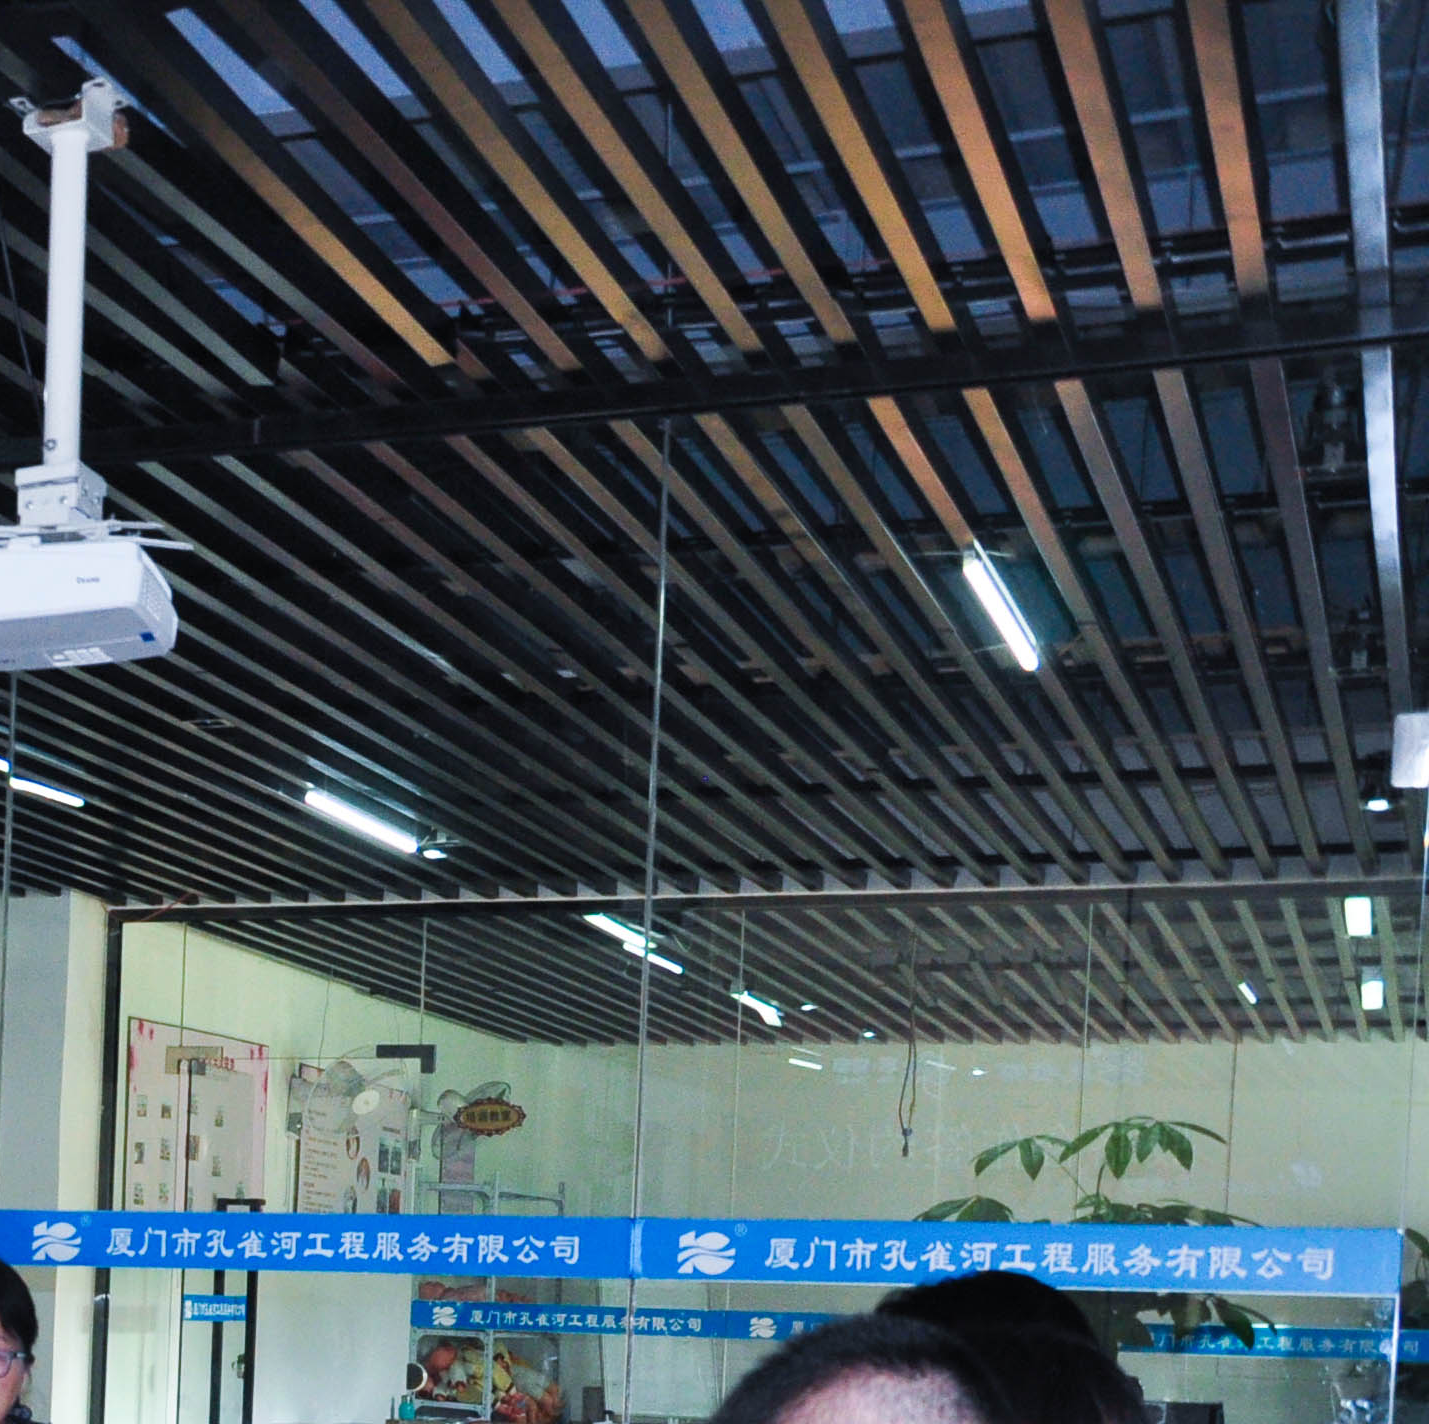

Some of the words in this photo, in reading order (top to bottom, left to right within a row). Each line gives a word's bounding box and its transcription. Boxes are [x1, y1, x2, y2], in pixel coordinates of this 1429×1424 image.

[106, 1227, 581, 1265] 厦门市孔雀河工程服务有限公司
[764, 1237, 1336, 1281] 厦门市孔雀河工程服务有限公司
